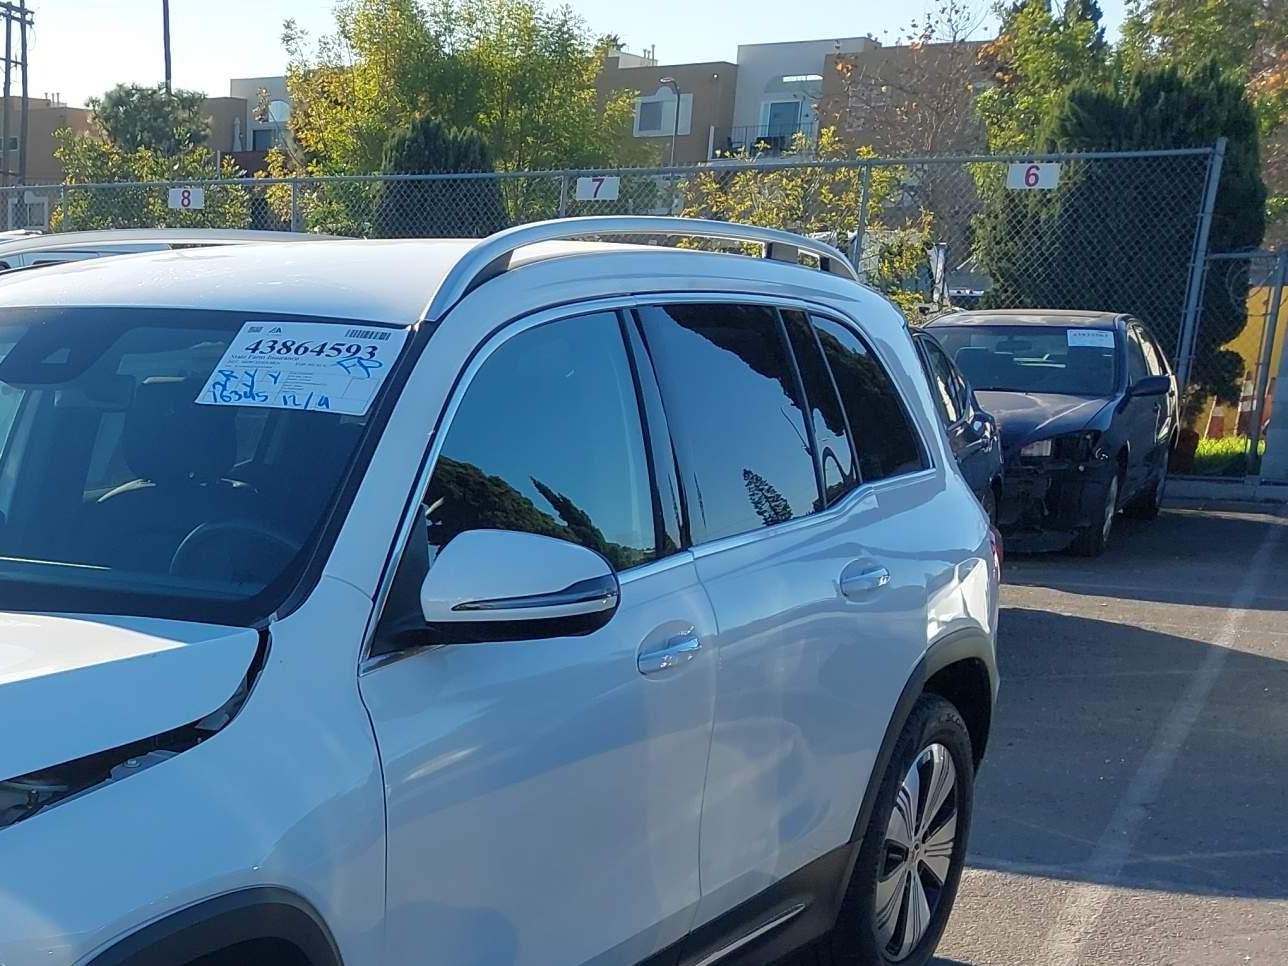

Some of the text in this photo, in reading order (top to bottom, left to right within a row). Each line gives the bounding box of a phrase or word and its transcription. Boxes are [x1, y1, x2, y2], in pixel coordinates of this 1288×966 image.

[1024, 164, 1040, 187] 6
[181, 189, 191, 207] 8
[592, 177, 605, 199] 7
[245, 339, 378, 361] 43864593
